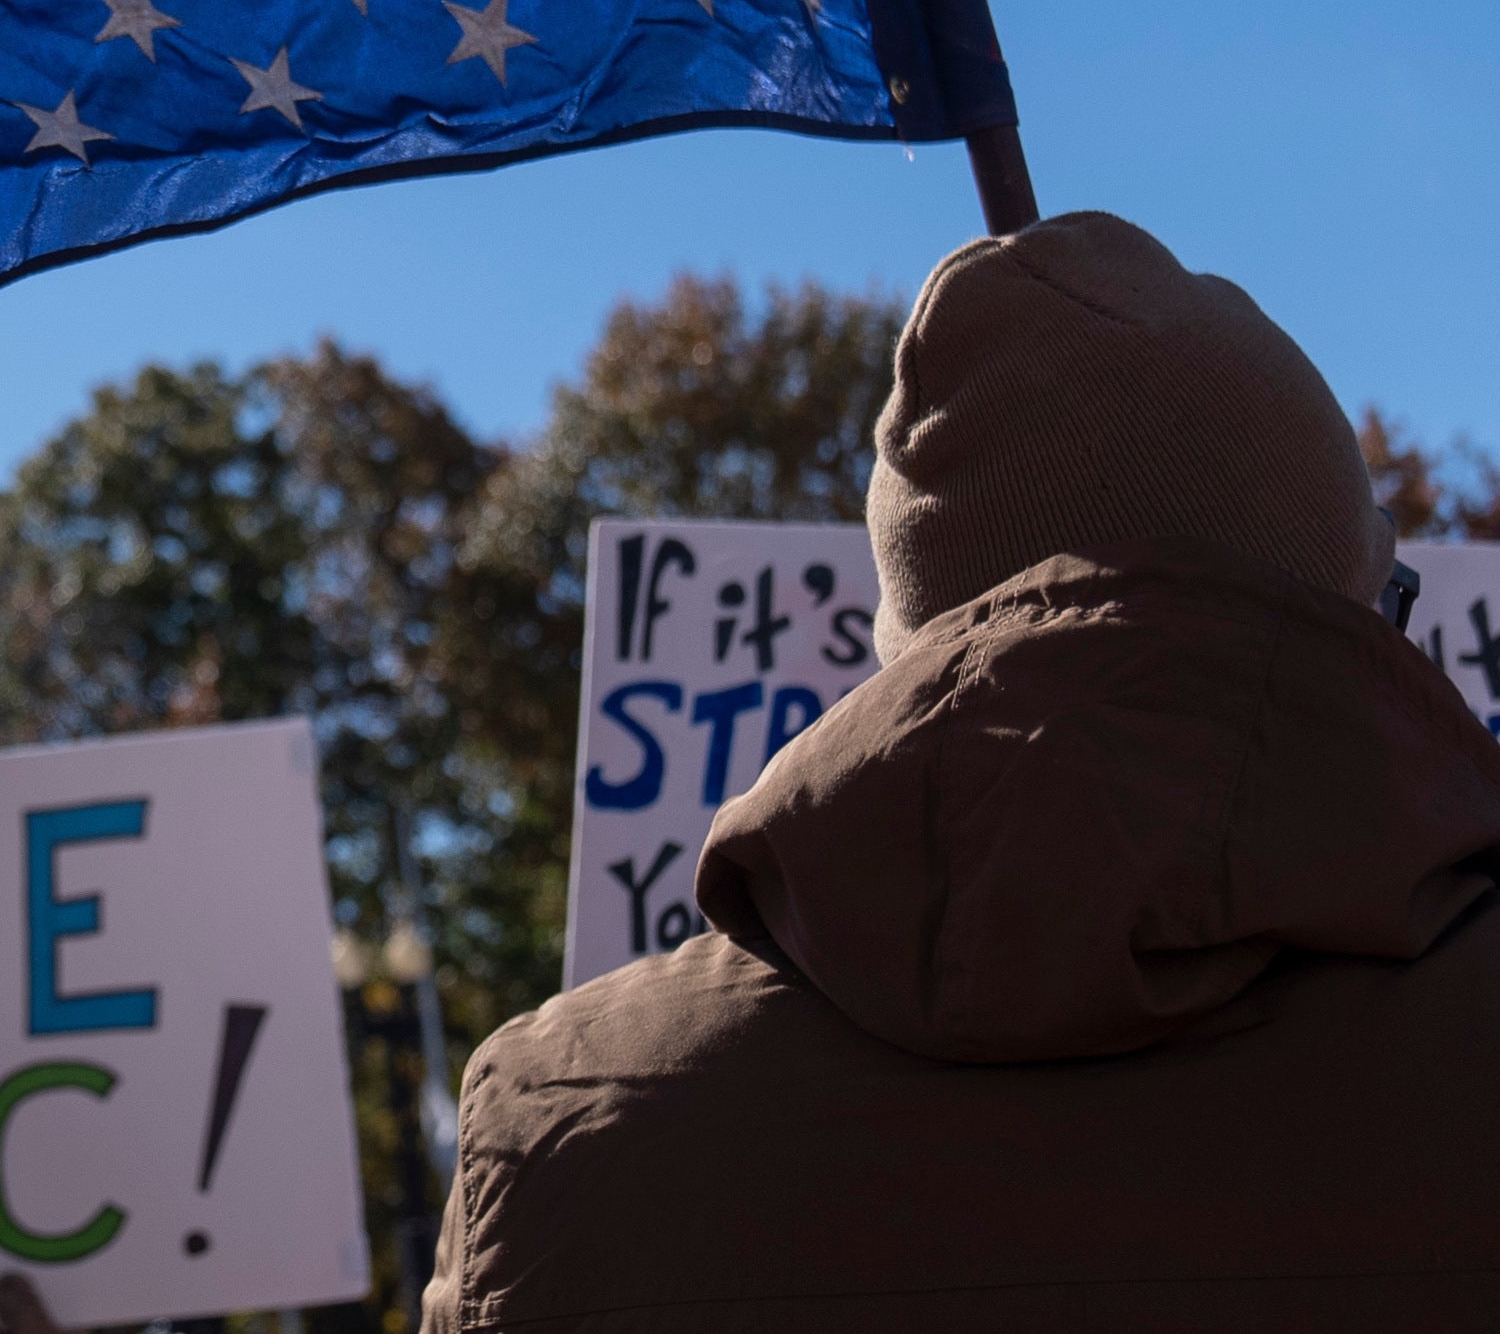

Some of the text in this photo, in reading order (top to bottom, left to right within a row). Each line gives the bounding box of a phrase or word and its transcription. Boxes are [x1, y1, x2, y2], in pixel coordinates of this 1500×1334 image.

[616, 533, 697, 663] If
[714, 564, 876, 673] it's
[607, 840, 708, 955] Yo
